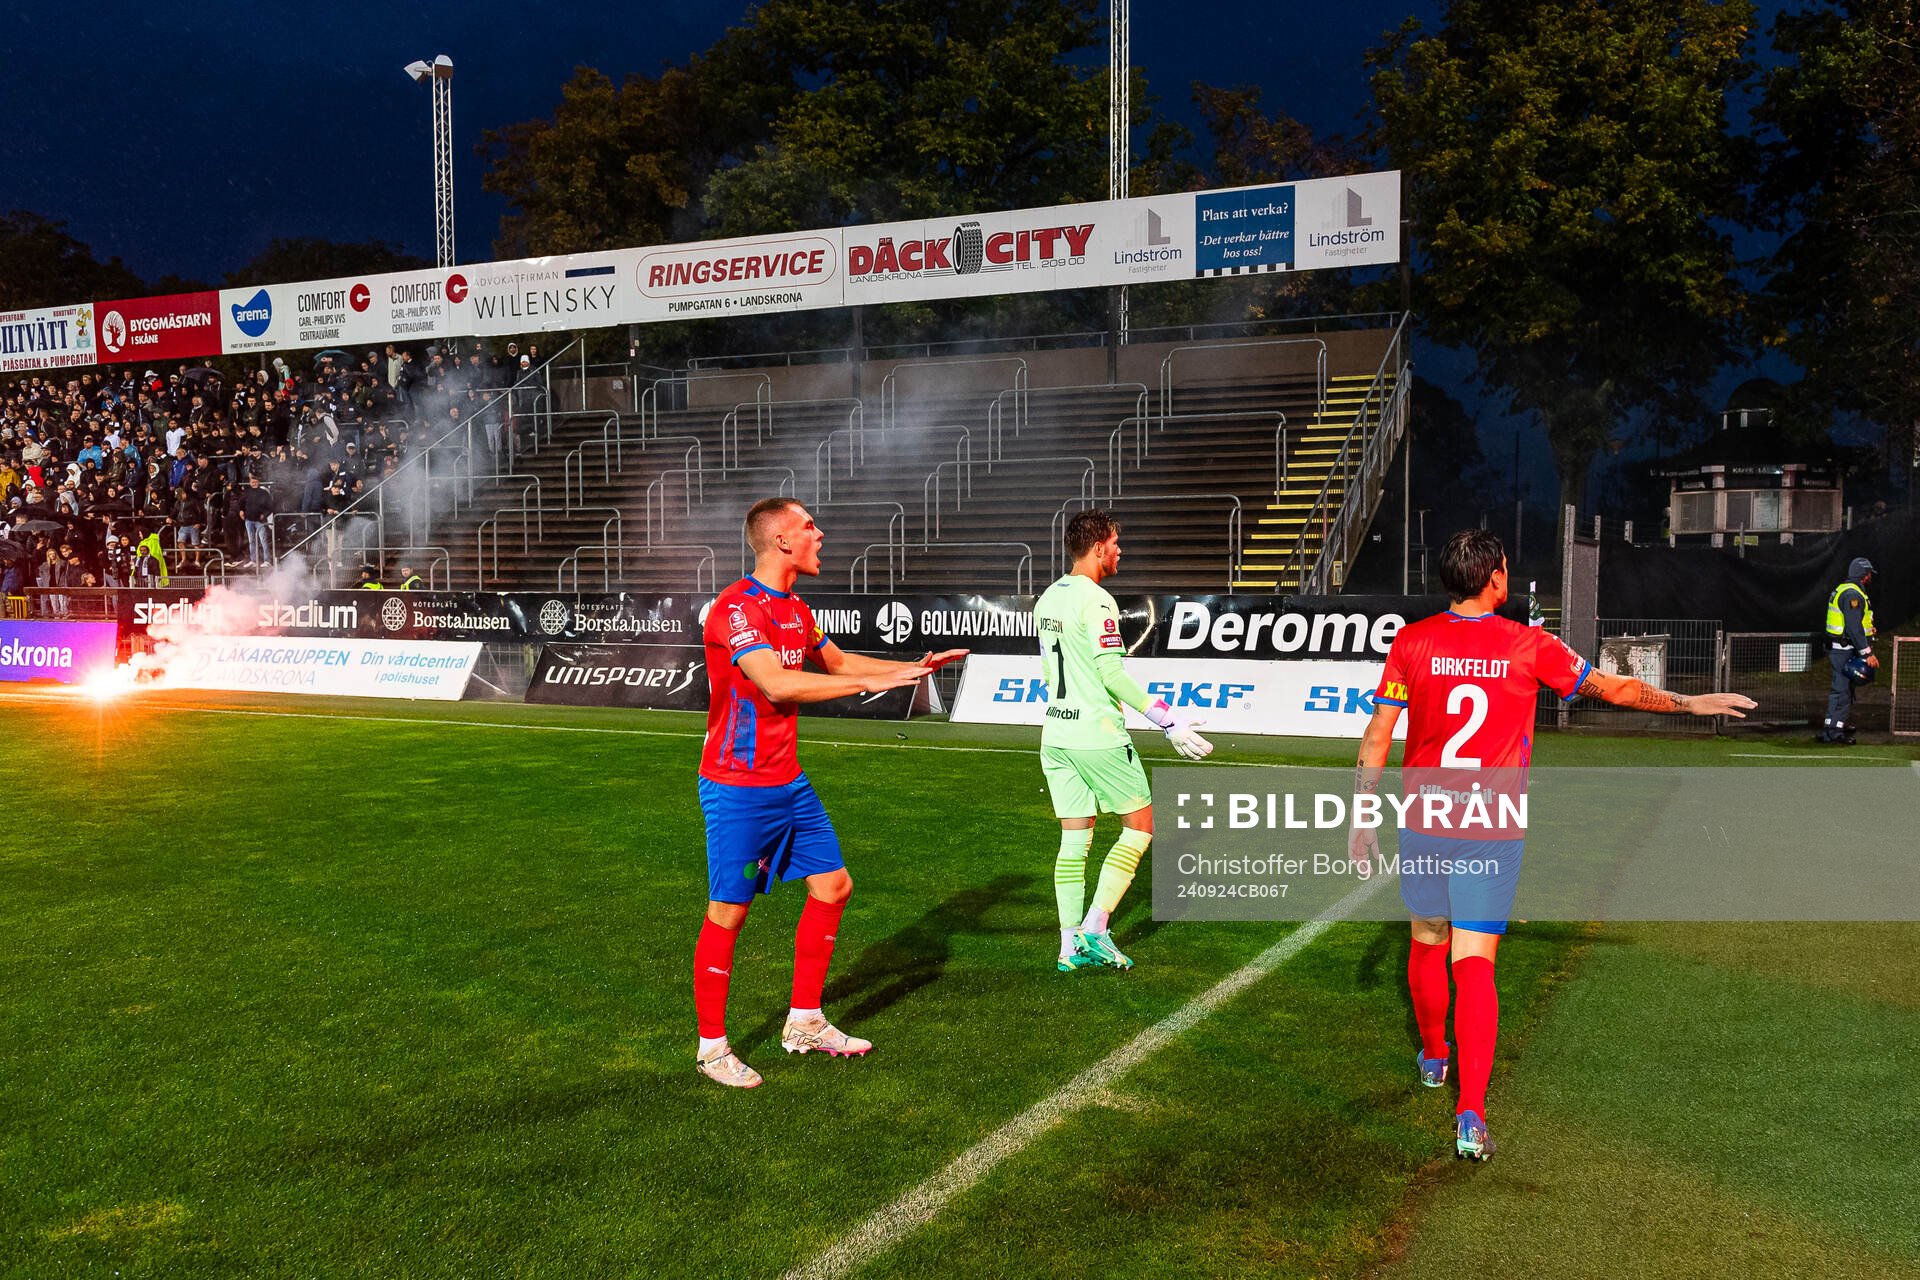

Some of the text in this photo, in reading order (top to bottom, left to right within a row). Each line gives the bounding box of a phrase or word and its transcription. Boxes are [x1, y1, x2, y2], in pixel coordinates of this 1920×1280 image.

[1202, 202, 1288, 221] Plats att verka?
[1200, 228, 1290, 246] -Det verkar bättre
[1310, 227, 1385, 248] Lindström
[849, 223, 1095, 276] DÄCK CITY
[1114, 247, 1182, 265] Lindström
[1223, 246, 1263, 259] hos oss!
[1324, 247, 1367, 257] Fastigheter
[648, 250, 825, 288] RINGSERVICE
[1015, 256, 1085, 271] TEL. 209 00
[1128, 264, 1167, 274] Fastigheter
[474, 271, 559, 287] ADVOKATFIRMAN
[849, 271, 923, 284] LANDSKRONA
[298, 290, 346, 313] COMFORT
[390, 281, 442, 304] COMFORT
[473, 285, 616, 319] WILENSKY
[668, 292, 803, 312] PUMPGATAN 6 LANDSKRONA
[236, 309, 269, 322] arema
[299, 313, 346, 327] CARL-PHILIPS VVS
[392, 305, 441, 319] CARL-PHILIPS VVS
[130, 312, 212, 332] BYGGMÄSTAR'N
[392, 321, 435, 334] CENTRALVÄRME
[0, 317, 68, 354] ILTVÄTT
[135, 333, 159, 345] SKÅNE
[299, 328, 340, 341] CENTRALVÄRME
[43, 358, 48, 368] &
[50, 353, 96, 367] PUMPGATAN!
[258, 600, 358, 629] stadium
[412, 601, 458, 609] MÖTESPLATS
[574, 603, 624, 611] MÖTESPLATS
[413, 611, 511, 630] Borstahusen
[573, 613, 683, 633] Borstahusen
[1167, 601, 1406, 654] Derome
[729, 630, 758, 645] UNIBET
[0, 638, 72, 668] skrona
[217, 643, 351, 666] LÄKARGRUPPEN
[360, 651, 469, 669] Din vårdcentral
[544, 665, 681, 688] UNISPORT
[1051, 637, 1067, 699] 1
[1431, 656, 1510, 679] BIRKFELDT
[380, 672, 440, 686] polishuset
[992, 678, 1048, 704] SK
[1147, 681, 1255, 709] SKF
[1304, 686, 1375, 715] SK
[1440, 683, 1489, 771] 2
[1419, 784, 1493, 804] tillmoil
